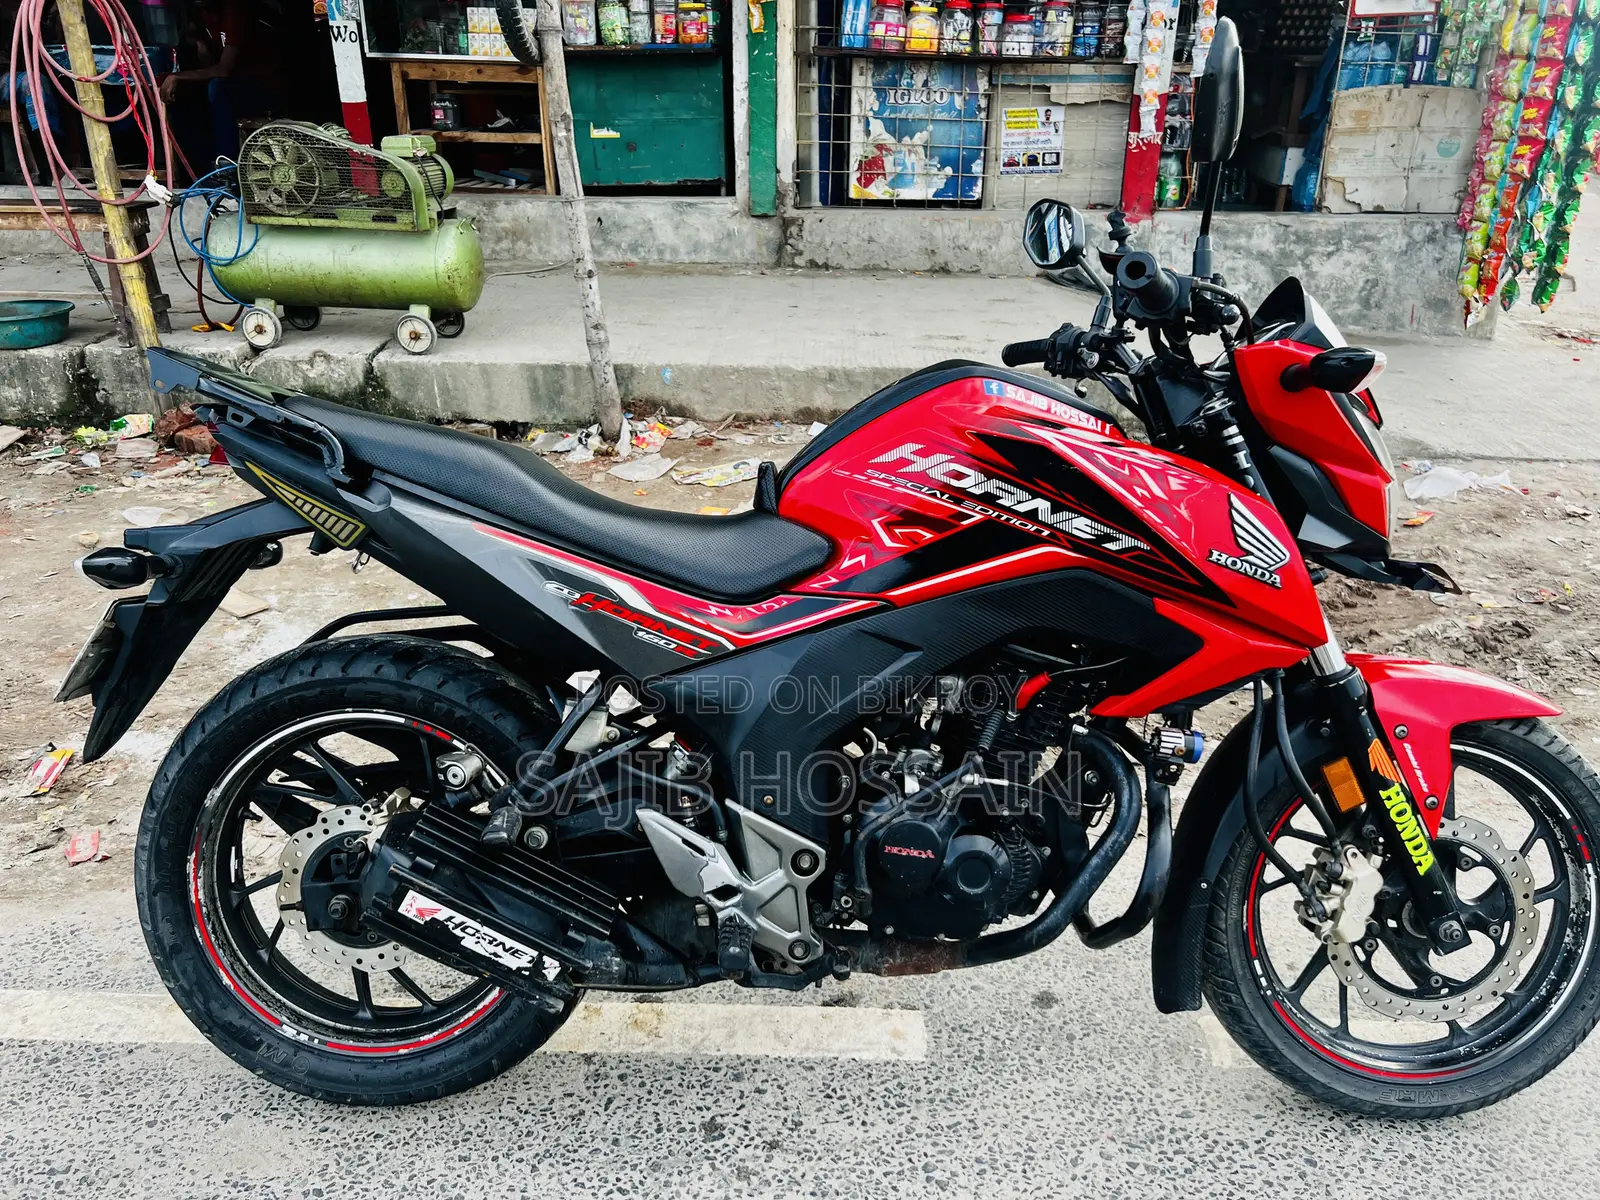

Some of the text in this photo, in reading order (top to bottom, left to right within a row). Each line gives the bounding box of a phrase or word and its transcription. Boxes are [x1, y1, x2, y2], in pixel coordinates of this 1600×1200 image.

[887, 88, 949, 105] IGLOO
[1006, 386, 1048, 411] SAJIB
[864, 469, 1051, 537] SPECIAL EDITION
[867, 442, 1150, 550] HORNET
[1207, 548, 1282, 589] HONDA
[569, 592, 720, 650] HORNET
[884, 845, 935, 859] HONDA
[1379, 783, 1434, 876] HONDA
